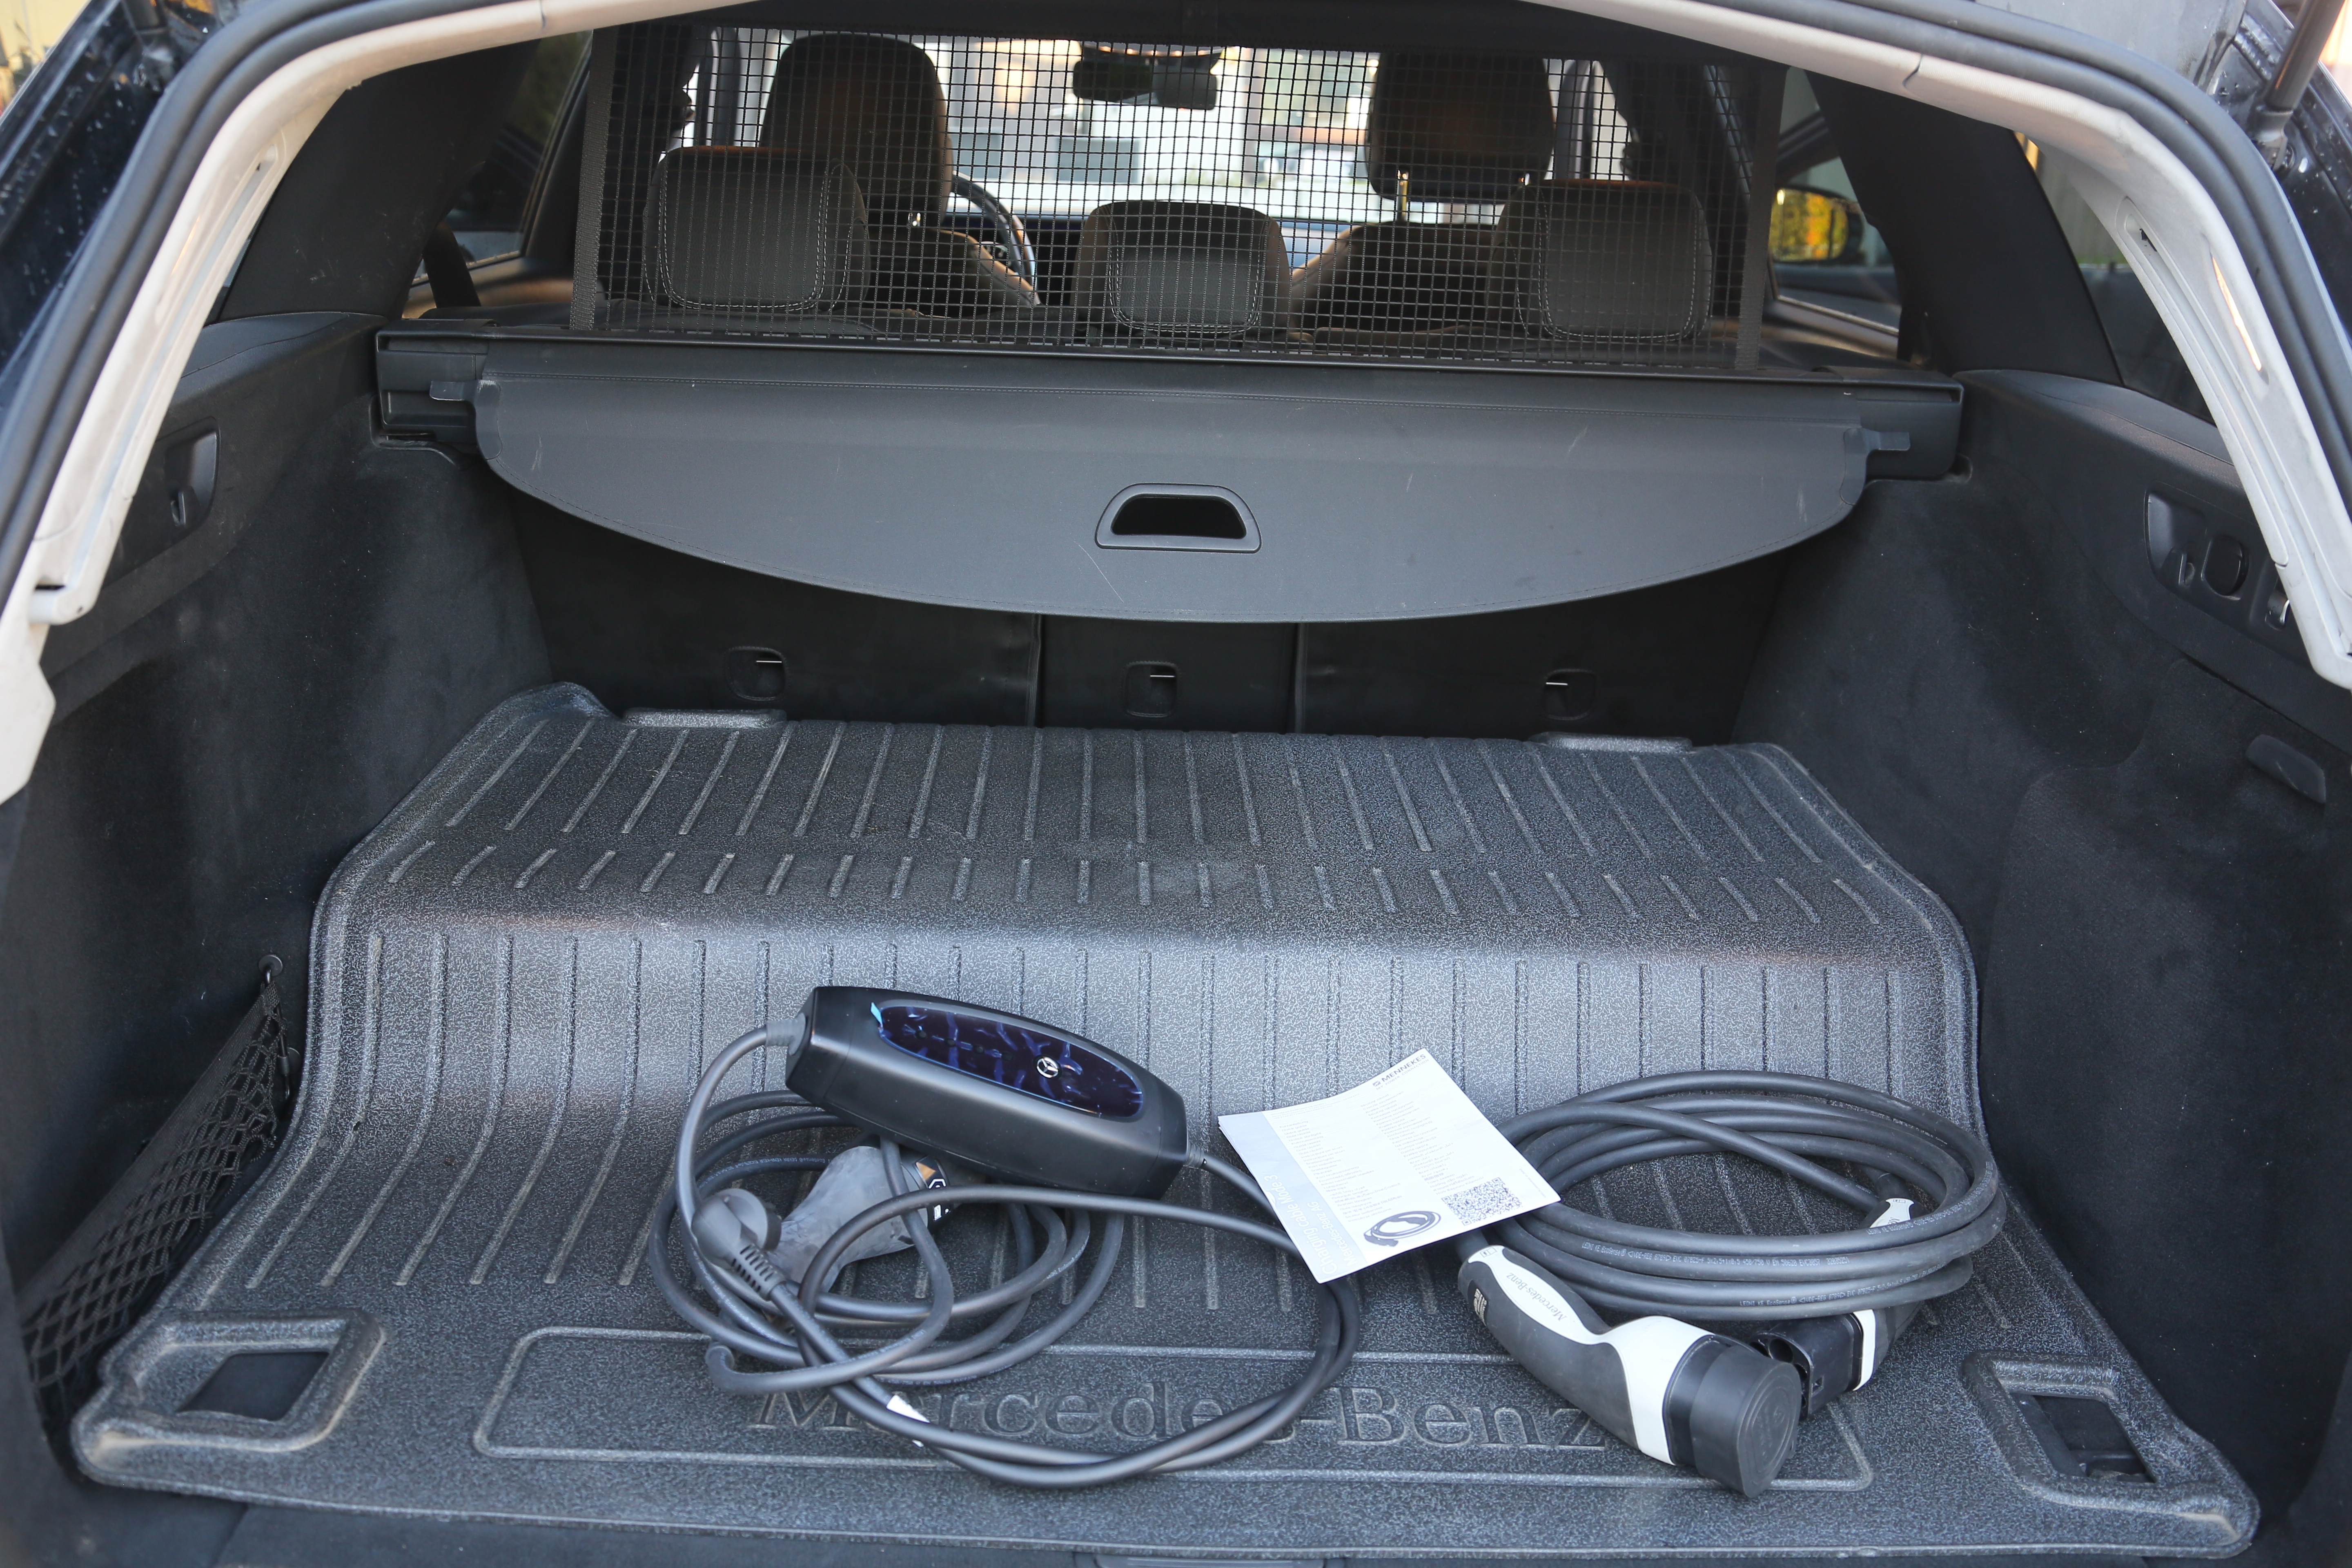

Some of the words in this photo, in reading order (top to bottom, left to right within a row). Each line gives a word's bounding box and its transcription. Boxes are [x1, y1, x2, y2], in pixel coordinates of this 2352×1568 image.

[1381, 1054, 1426, 1082] MENNEKES
[1385, 1075, 1401, 1086] POWER
[1401, 1059, 1430, 1076] CONNECTION
[1271, 1181, 1294, 1204] Mode
[1287, 1203, 1310, 1227] cable
[1307, 1201, 1323, 1212] AG
[1303, 1227, 1337, 1274] Charging
[1316, 1212, 1358, 1267] Mercedes-Benz
[1581, 1241, 1593, 1251] LEONI
[1506, 1272, 1568, 1321] Mercedes-Benz
[746, 1382, 1608, 1450] Mrcede-Benz
